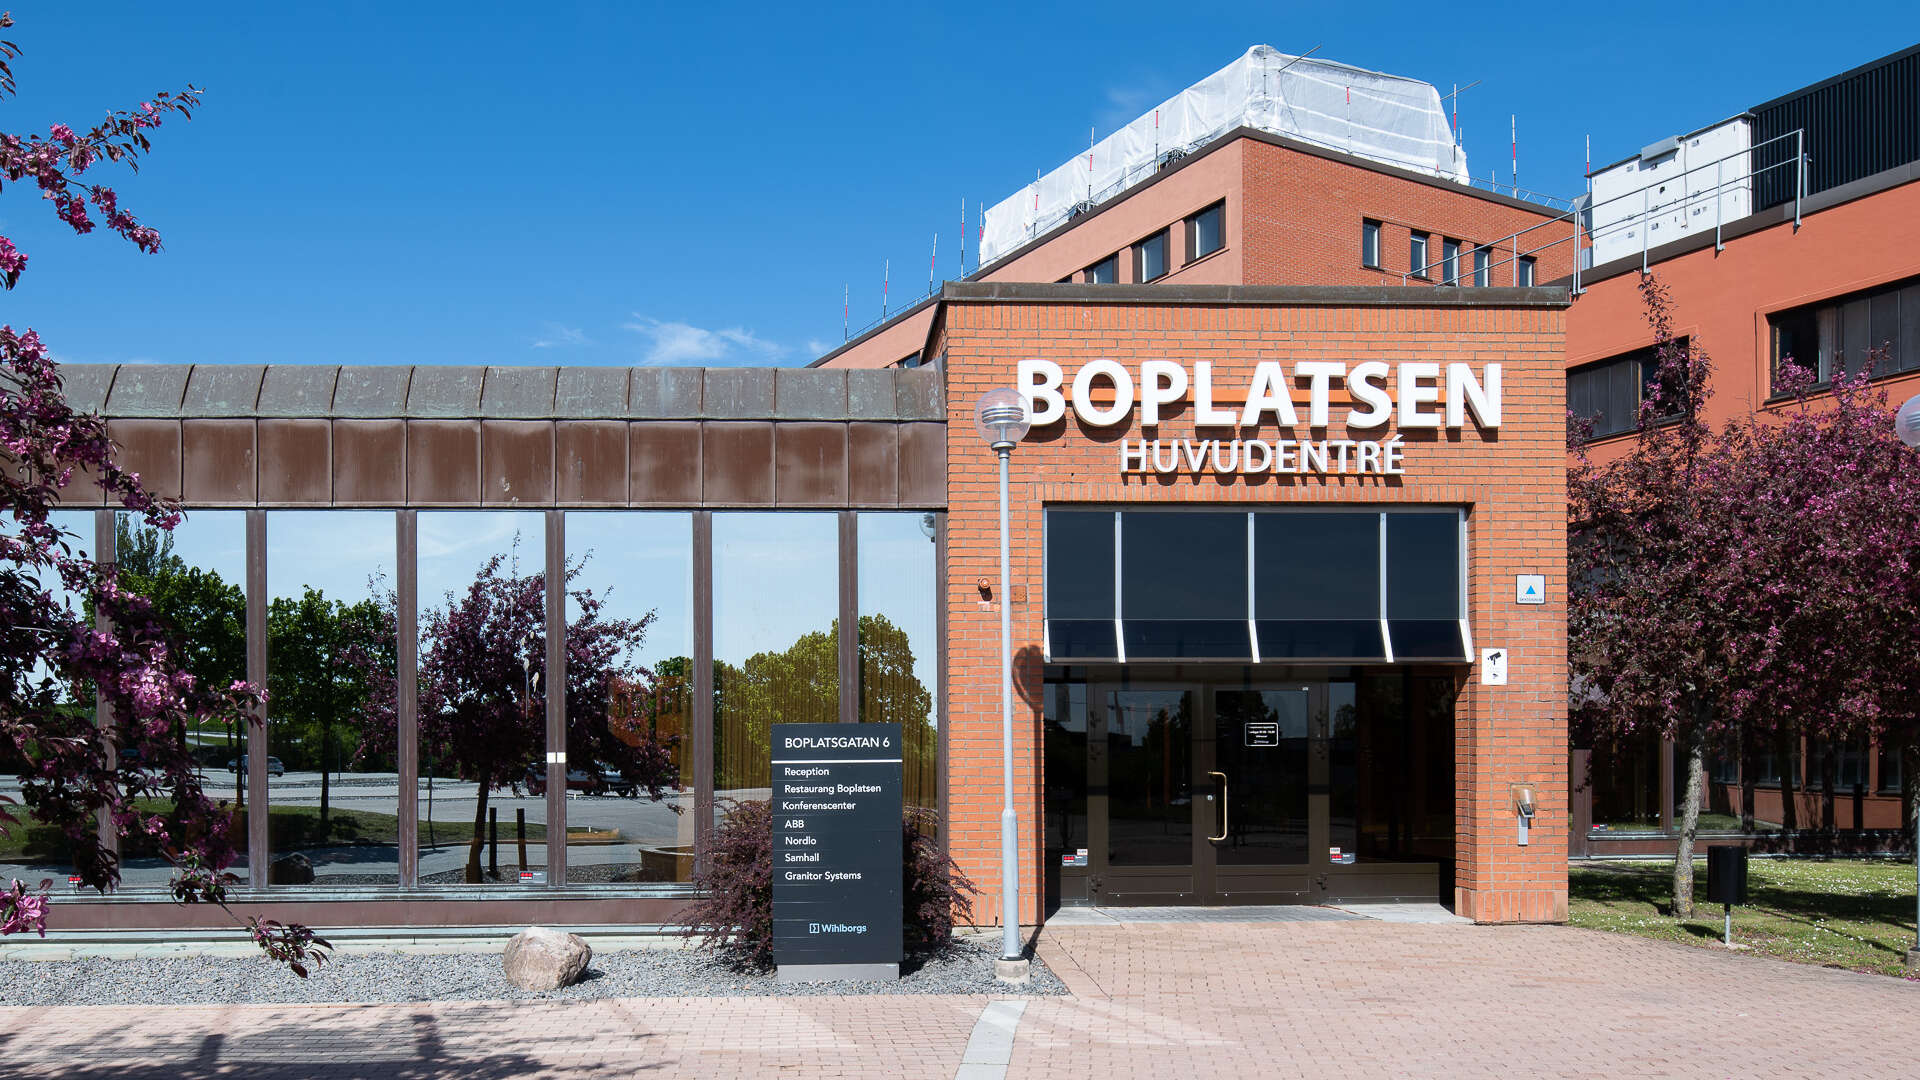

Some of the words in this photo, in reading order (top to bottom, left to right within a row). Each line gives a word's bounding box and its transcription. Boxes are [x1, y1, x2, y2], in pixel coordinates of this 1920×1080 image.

[1017, 359, 1502, 428] BOPLATSEN
[1120, 434, 1406, 475] HUVUDENTRÉ
[785, 737, 880, 748] BOPLATSGATAN
[882, 737, 890, 748] 6
[784, 767, 830, 779] Reception
[784, 784, 835, 795] Restaurang
[837, 784, 881, 795] Boplatsen
[782, 801, 856, 810] Konferenscenter
[785, 820, 804, 828] ABB
[785, 836, 817, 845] Nordlo
[785, 853, 820, 862] Samhall
[785, 871, 822, 880] Granitor
[825, 871, 862, 882] Systems
[821, 923, 867, 934] Wihlborgs
